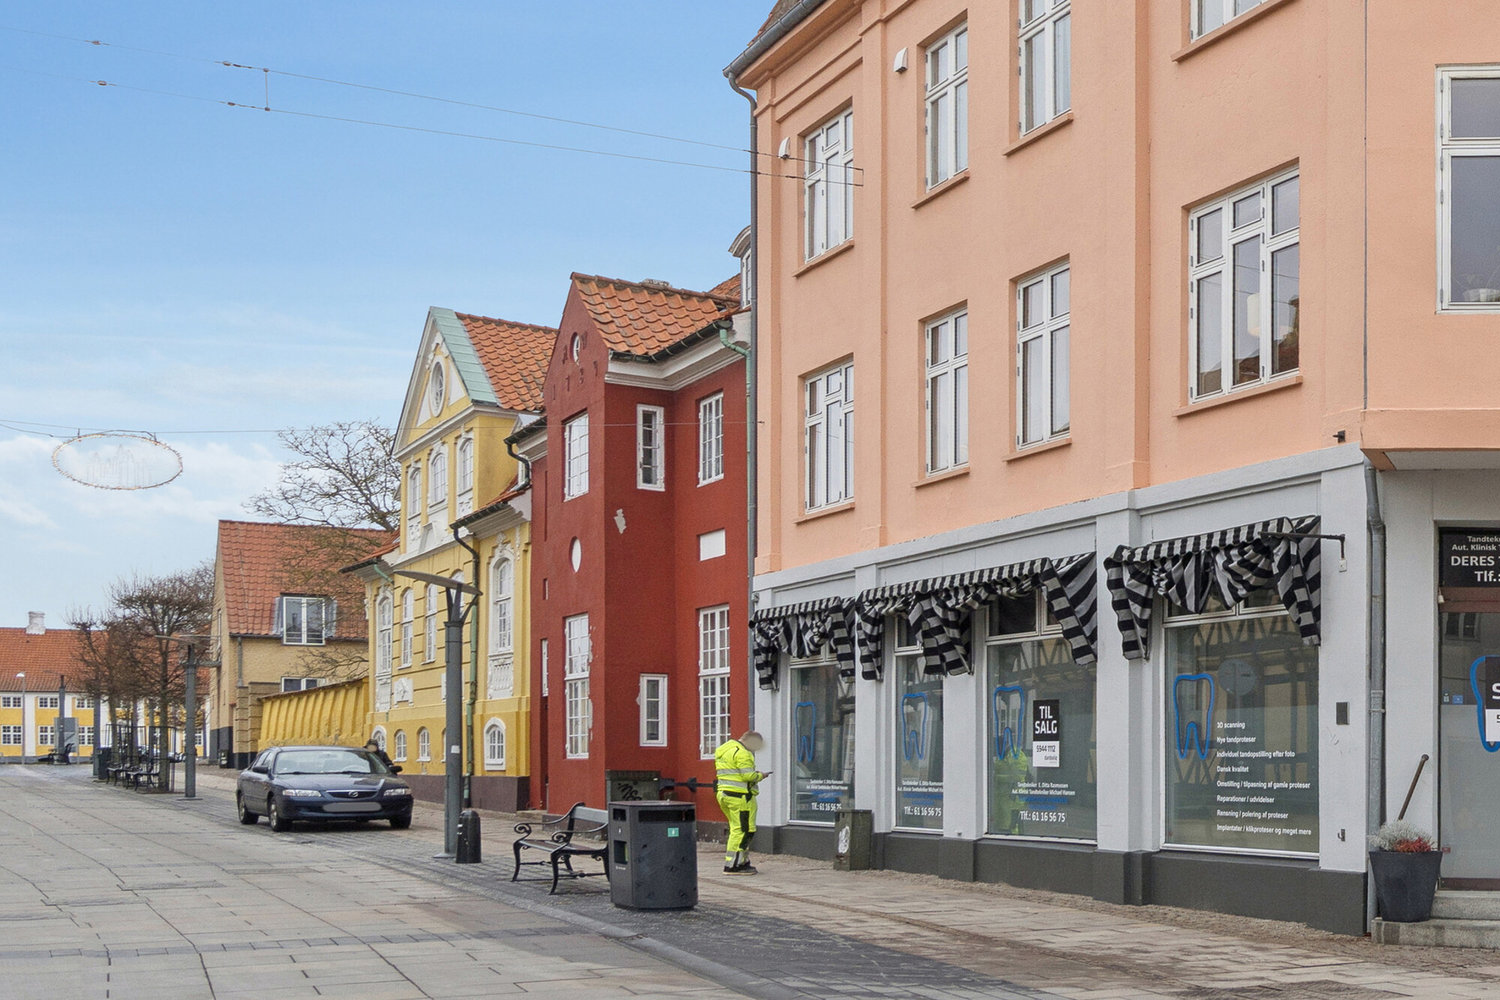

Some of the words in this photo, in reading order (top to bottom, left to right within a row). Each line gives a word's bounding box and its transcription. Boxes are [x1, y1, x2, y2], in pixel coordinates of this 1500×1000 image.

[1451, 556, 1495, 566] DERES
[1039, 706, 1053, 719] TIL
[1035, 721, 1057, 734] SALG
[1244, 781, 1266, 789] tilpasning
[1032, 812, 1039, 821] 61
[1041, 812, 1048, 821] 16
[1049, 813, 1056, 821] 56
[1058, 813, 1065, 822] 75
[1217, 810, 1238, 818] Rensning
[1242, 811, 1261, 819] polering
[1246, 825, 1274, 833] klikproteser
[1282, 827, 1297, 835] meget
